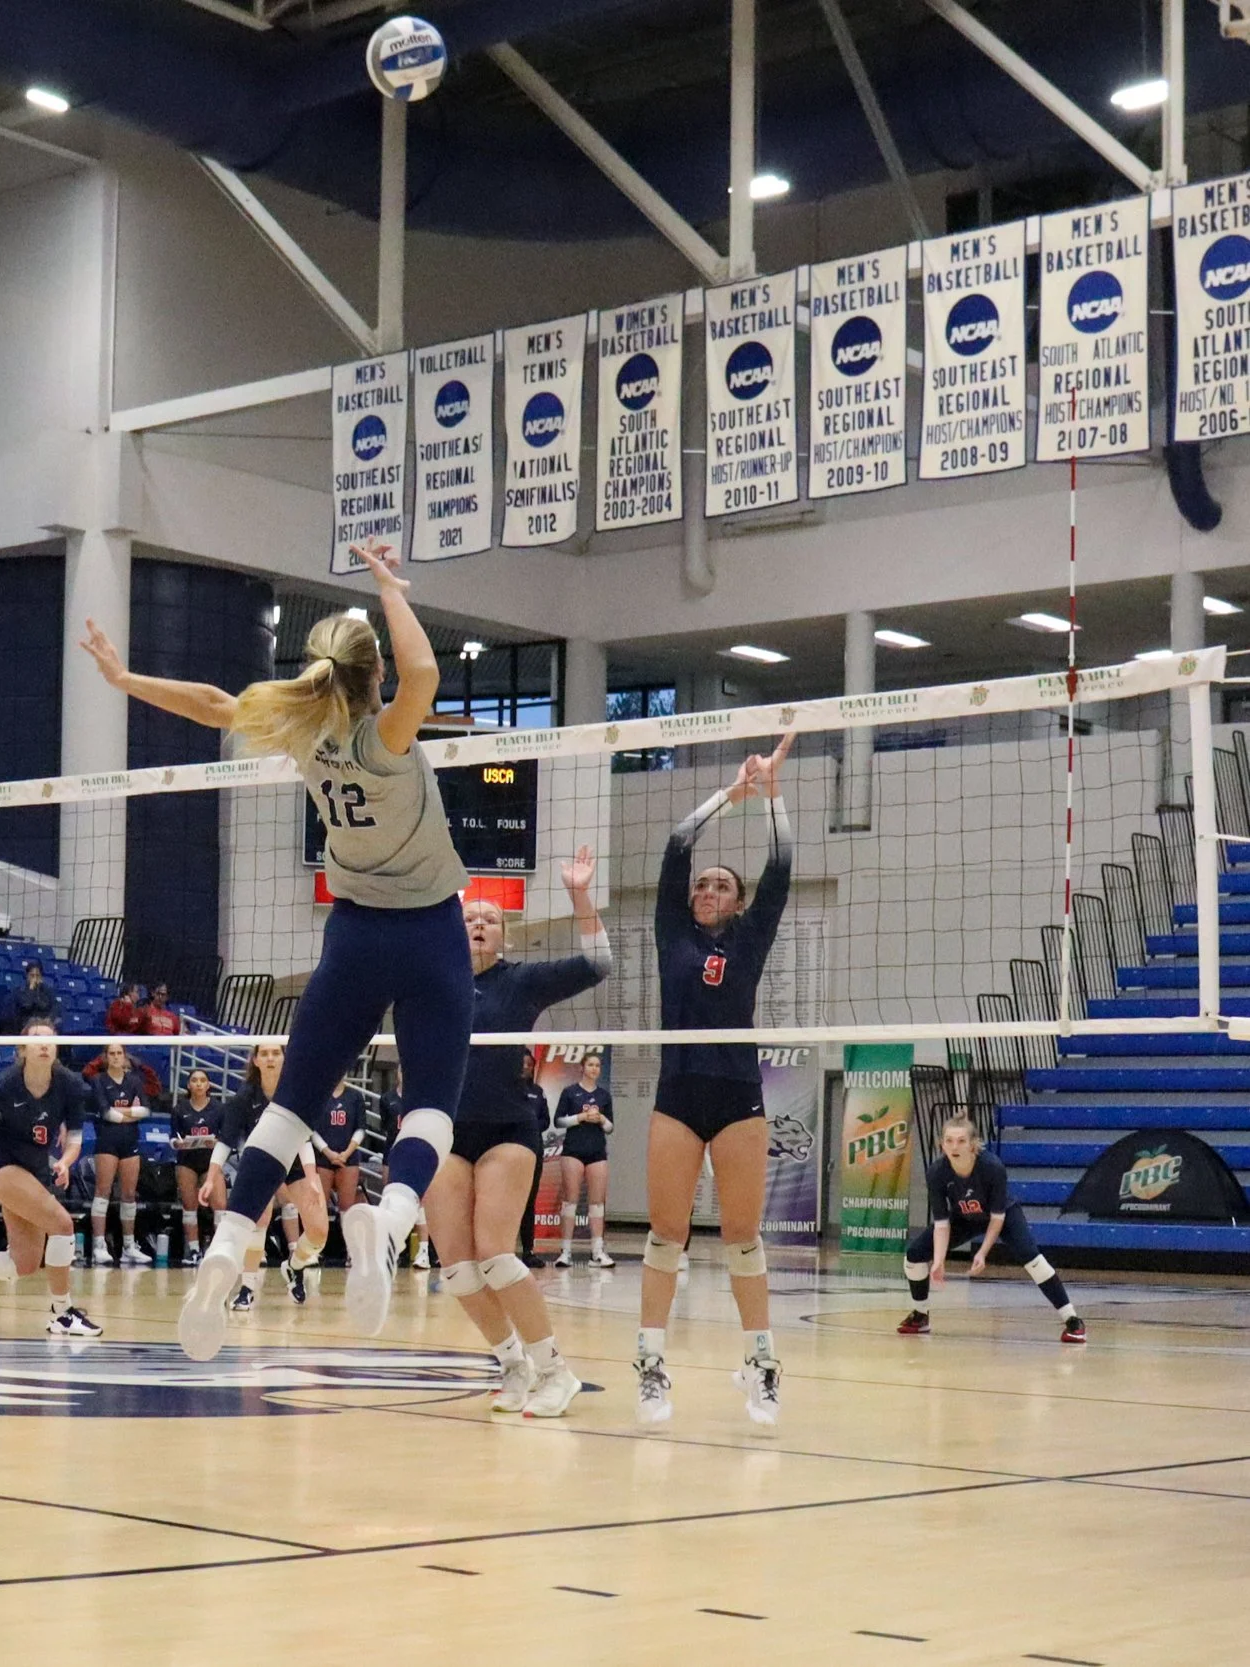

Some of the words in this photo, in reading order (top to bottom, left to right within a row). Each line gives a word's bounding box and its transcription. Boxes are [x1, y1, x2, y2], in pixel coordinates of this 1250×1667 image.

[389, 34, 432, 52] molten
[1071, 210, 1119, 240] MEN'S
[950, 235, 997, 263] MEN'S
[1046, 235, 1142, 273] BASKETBALL
[837, 259, 880, 286] MEN'S
[926, 257, 1020, 294] BASKETBALL
[730, 284, 770, 311] MEN'S
[813, 281, 900, 317] BASKETBALL
[1071, 296, 1122, 322] NCAA
[615, 304, 668, 333] WOMEN'S
[710, 305, 792, 341] BASKETBALL
[1205, 302, 1250, 330] SOUT
[527, 331, 563, 355] MEN'S
[601, 326, 679, 358] BASKETBALL
[950, 320, 998, 345] NCAA
[420, 345, 486, 375] VOLLEYBALL
[835, 340, 881, 365] NCAA
[1042, 342, 1078, 368] SOUTH
[1092, 331, 1145, 361] ATLANTIC
[355, 362, 386, 385] MEN'S
[523, 358, 567, 384] TENNIS
[729, 365, 773, 390] NCAA
[932, 355, 1018, 391] SOUTHEAST
[1053, 363, 1131, 395] REGIONAL
[337, 385, 403, 414] BASKETBALL
[619, 377, 660, 399] NCAA
[818, 377, 901, 411] SOUTHEAST
[938, 385, 1010, 418] REGIONAL
[436, 400, 470, 418] NCAA
[619, 409, 657, 435] SOUTH
[710, 398, 791, 431] SOUTHEAST
[824, 405, 894, 437] REGIONAL
[524, 415, 565, 436] NCAA
[925, 410, 1023, 445] HOST/CHAMPIONS
[356, 435, 387, 451] NCAA
[610, 429, 669, 457] ATLANTIC
[716, 427, 786, 458] REGIONAL
[813, 430, 903, 465] HOST/CHAMPIONS
[609, 451, 668, 478] REGIONAL
[711, 451, 793, 485] HOST/RUNNER-UP
[940, 441, 1009, 472] 2008-09
[336, 465, 401, 492] SOUTHEAST
[426, 466, 475, 491] REGIONAL
[604, 472, 672, 500] CHAMPIONS
[827, 461, 889, 490] 2009-10
[341, 492, 395, 517] REGIONAL
[427, 494, 478, 520] CHAMPIONS
[603, 495, 672, 522] 2003-2004
[725, 481, 779, 509] 2010-11
[439, 527, 463, 548] 2021
[528, 513, 557, 536] 2012
[1037, 675, 1085, 689] PEAH
[839, 698, 882, 711] PEACH
[887, 693, 918, 705] BELT
[483, 768, 514, 784] USCA
[321, 780, 376, 827] 12
[497, 819, 526, 830] FOULS
[496, 858, 526, 868] SCORE
[702, 955, 727, 986] 9
[758, 1048, 810, 1067] PBC
[844, 1070, 912, 1088] WELCOME
[330, 1110, 347, 1126] 16
[33, 1125, 48, 1145] 3
[847, 1120, 908, 1166] PBC
[1119, 1155, 1183, 1199] PBC
[842, 1197, 909, 1211] CHAMPIONSHIP
